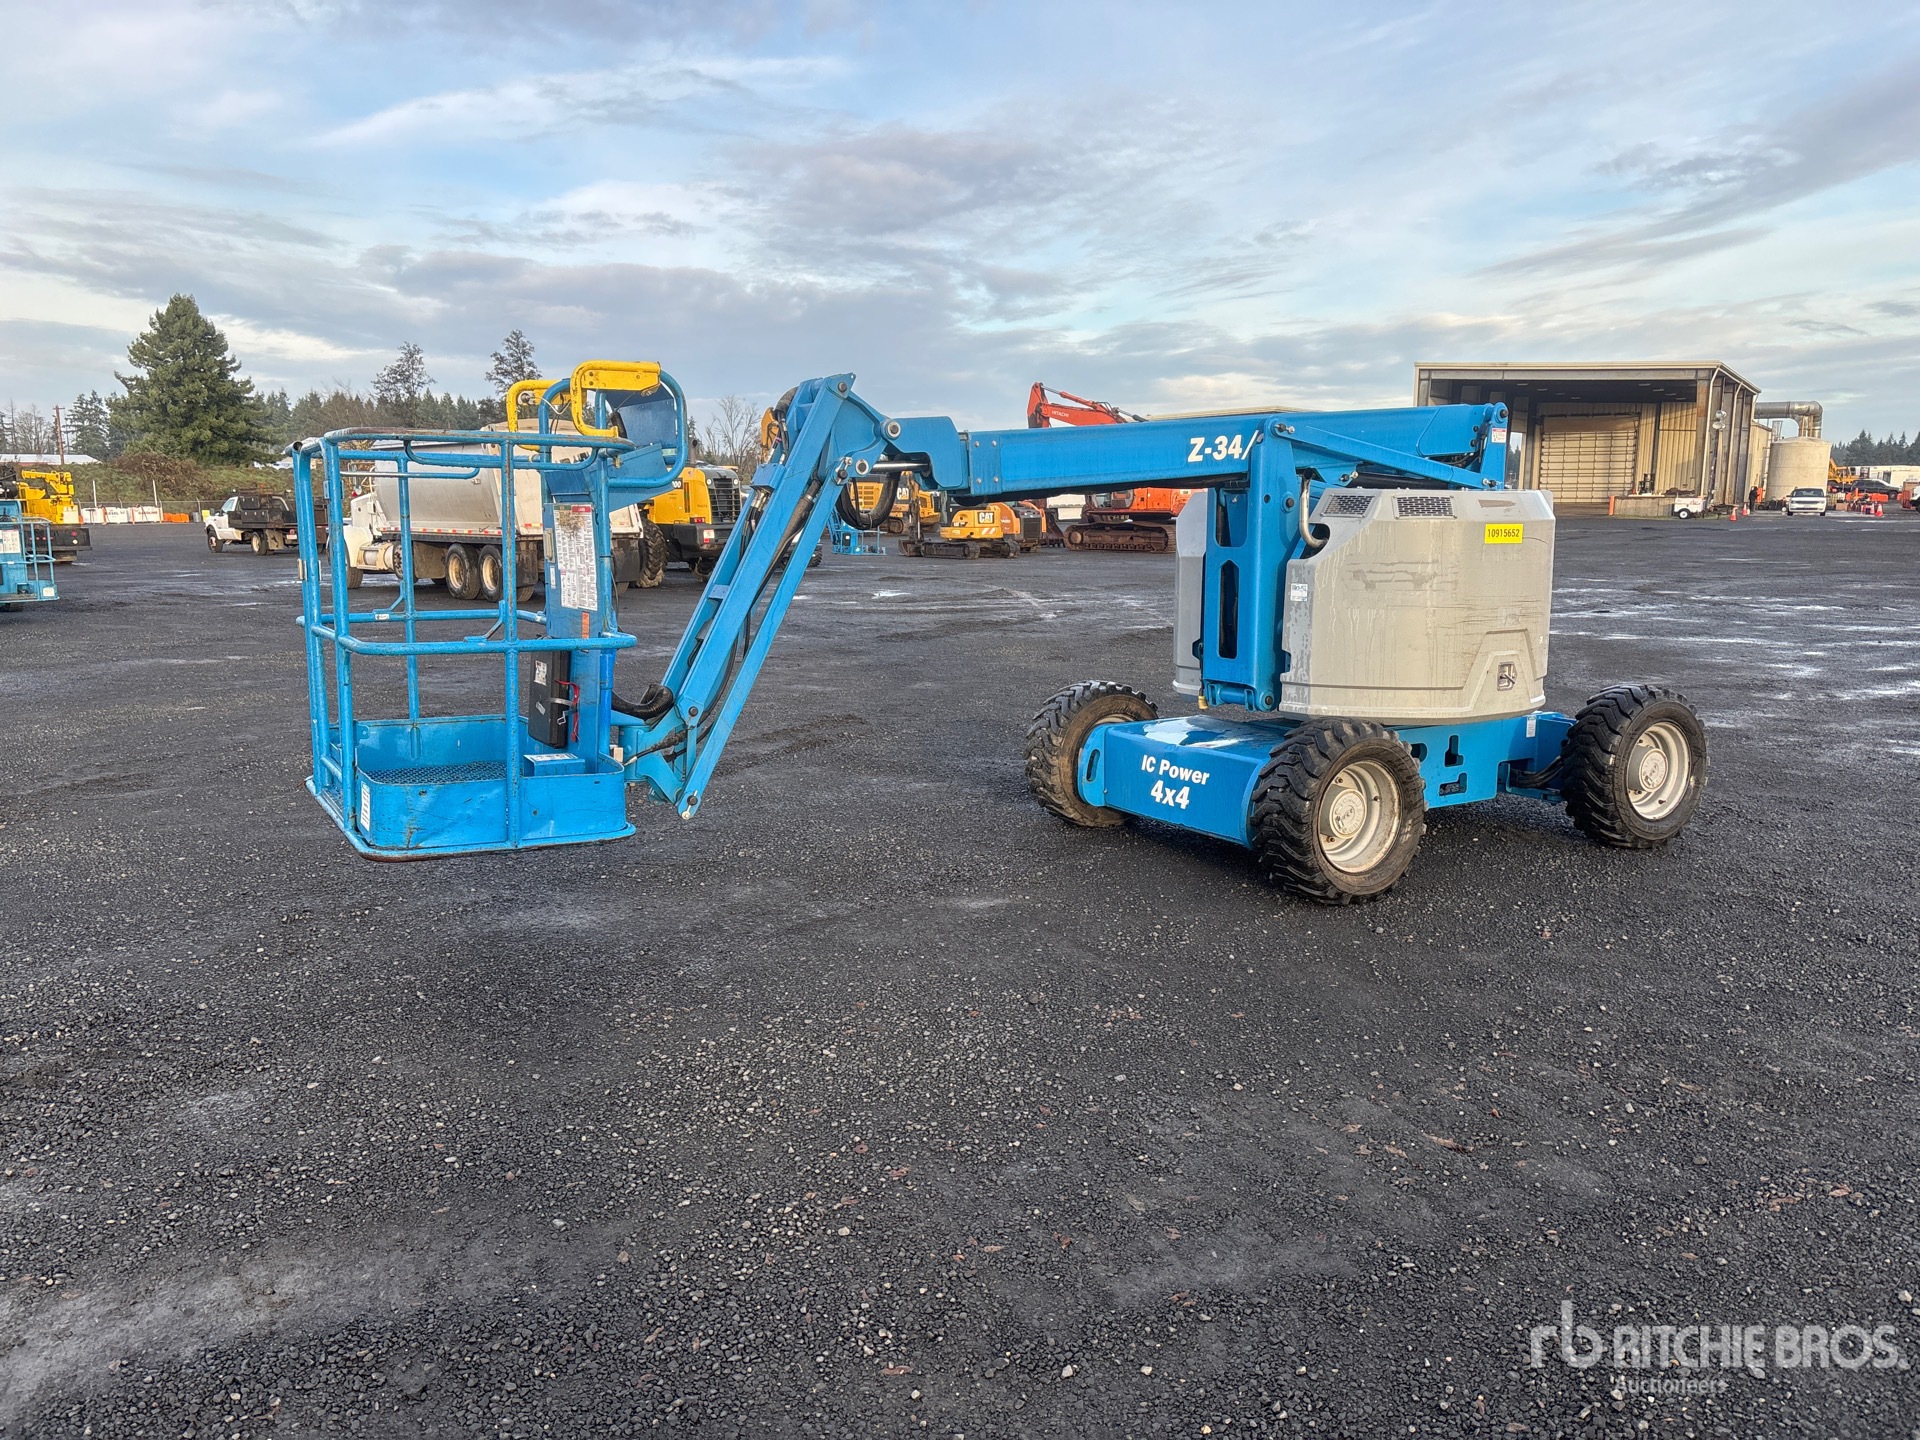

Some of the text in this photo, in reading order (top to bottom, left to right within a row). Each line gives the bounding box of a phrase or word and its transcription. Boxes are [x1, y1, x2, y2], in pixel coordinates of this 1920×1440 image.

[979, 512, 994, 524] CAT
[1487, 528, 1520, 538] 10915652
[1141, 754, 1210, 785] IC Power
[1150, 779, 1190, 810] 4x4
